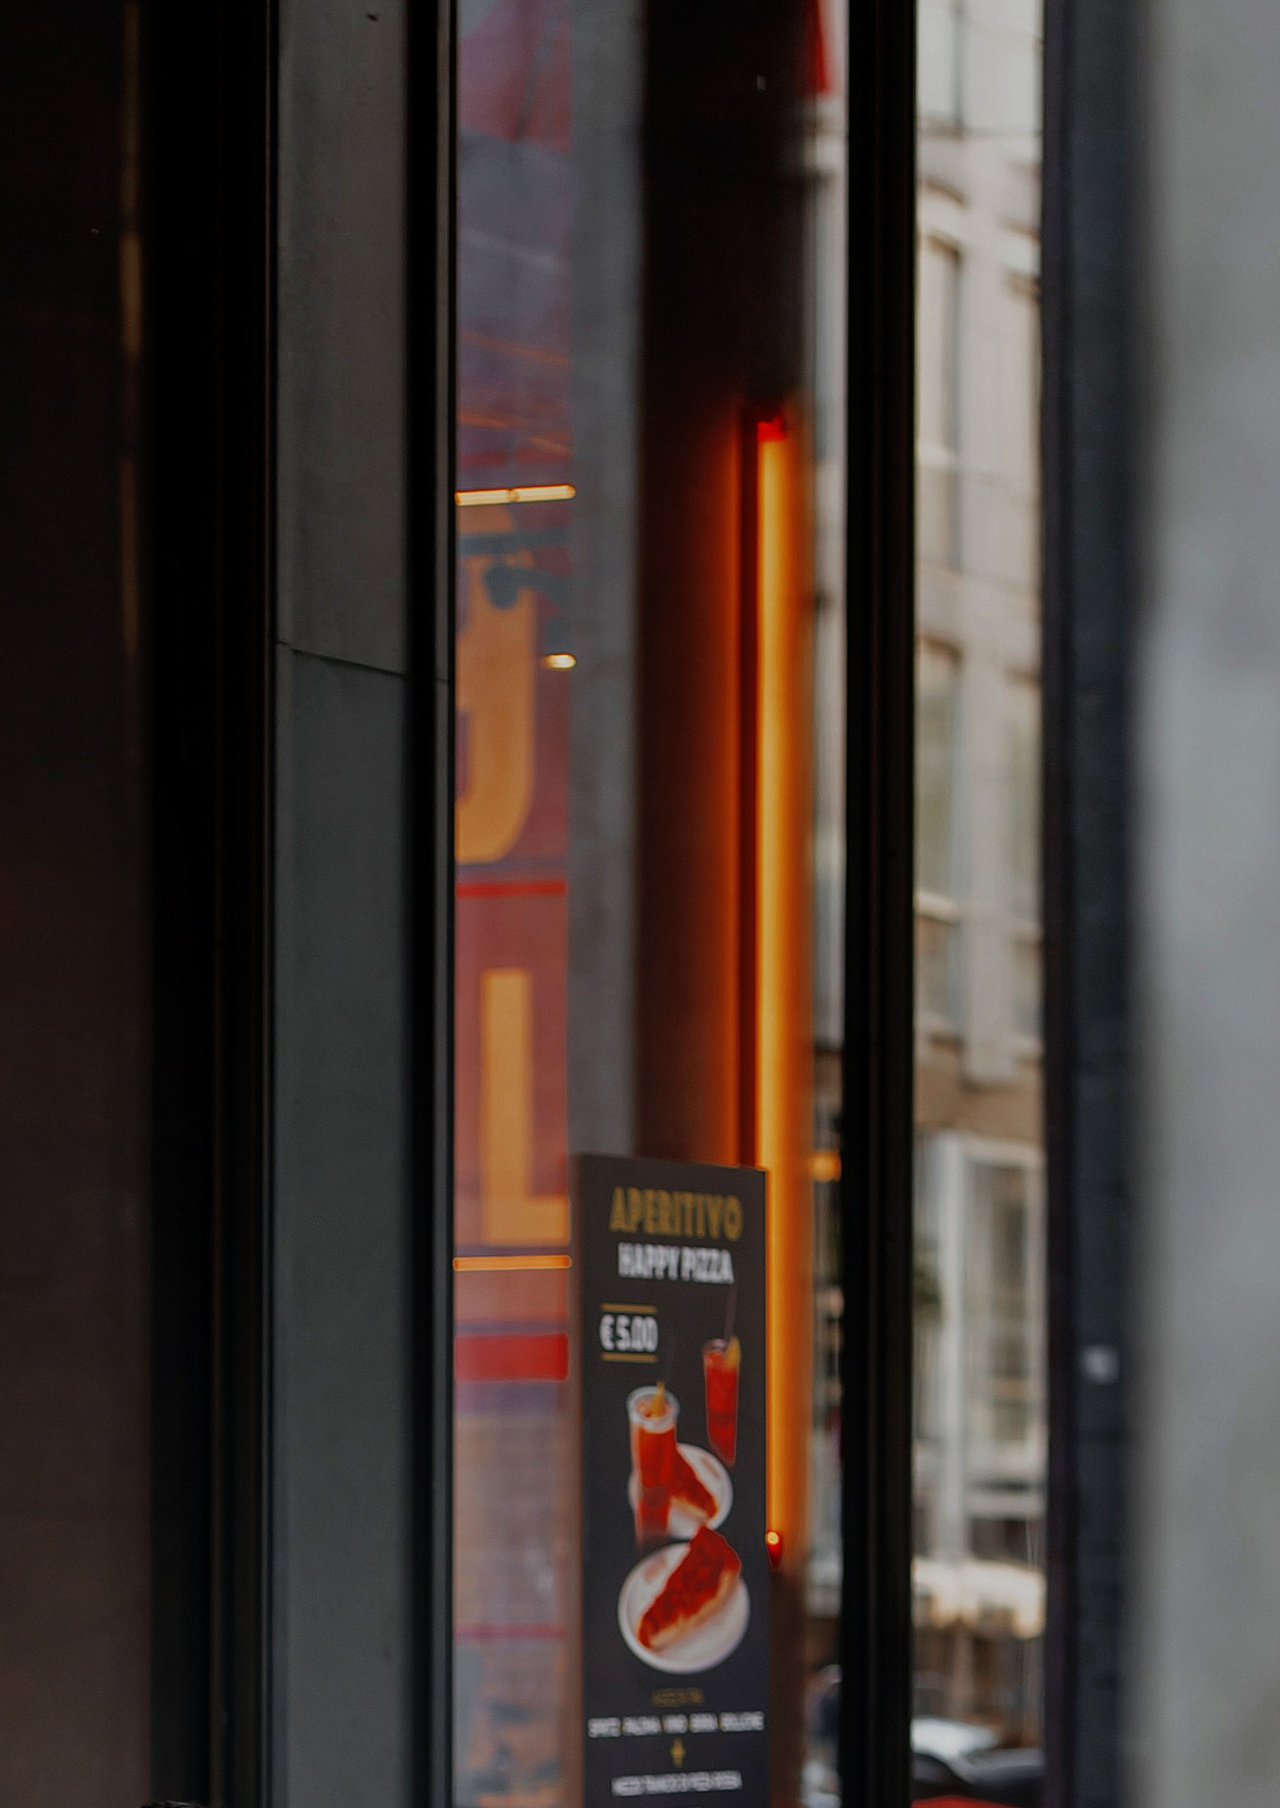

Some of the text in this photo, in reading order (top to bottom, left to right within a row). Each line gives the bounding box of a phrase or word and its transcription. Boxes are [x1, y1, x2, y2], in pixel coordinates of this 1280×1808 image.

[609, 1186, 744, 1242] APERITIVO
[618, 1242, 735, 1285] HAPPY PIZZA
[600, 1314, 659, 1353] € 5.00
